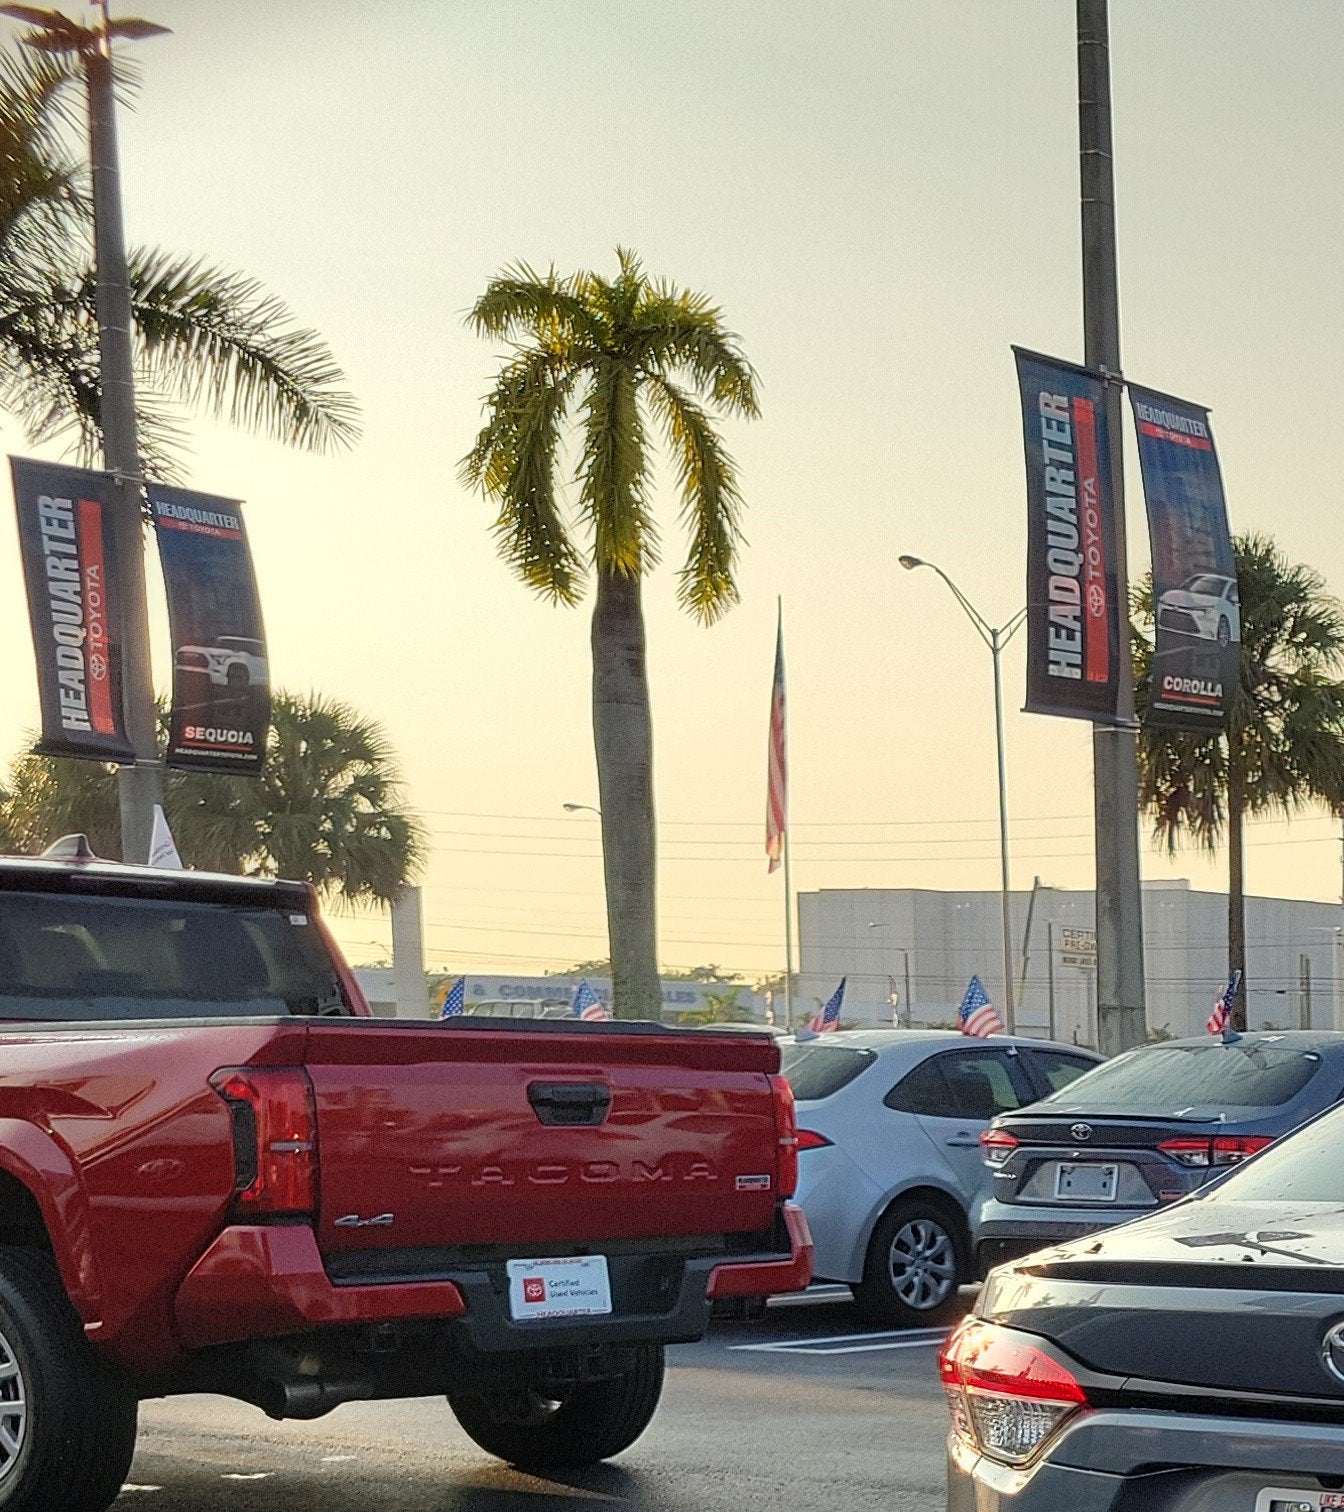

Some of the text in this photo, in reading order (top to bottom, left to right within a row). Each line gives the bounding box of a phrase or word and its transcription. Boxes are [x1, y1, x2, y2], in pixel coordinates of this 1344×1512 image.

[1136, 402, 1208, 437] HEADQUARTER
[156, 501, 240, 530] HEADQUARTER
[1083, 477, 1102, 581] TOYOTA
[1039, 391, 1084, 680] HEADQUARTER
[36, 494, 93, 732] HEADQUARTER
[86, 564, 103, 650] TOYOTA
[1163, 675, 1223, 698] COROLLA
[185, 725, 254, 745] SEQUOIA
[410, 1160, 718, 1187] TACOMA
[1320, 1493, 1338, 1507] LIKE
